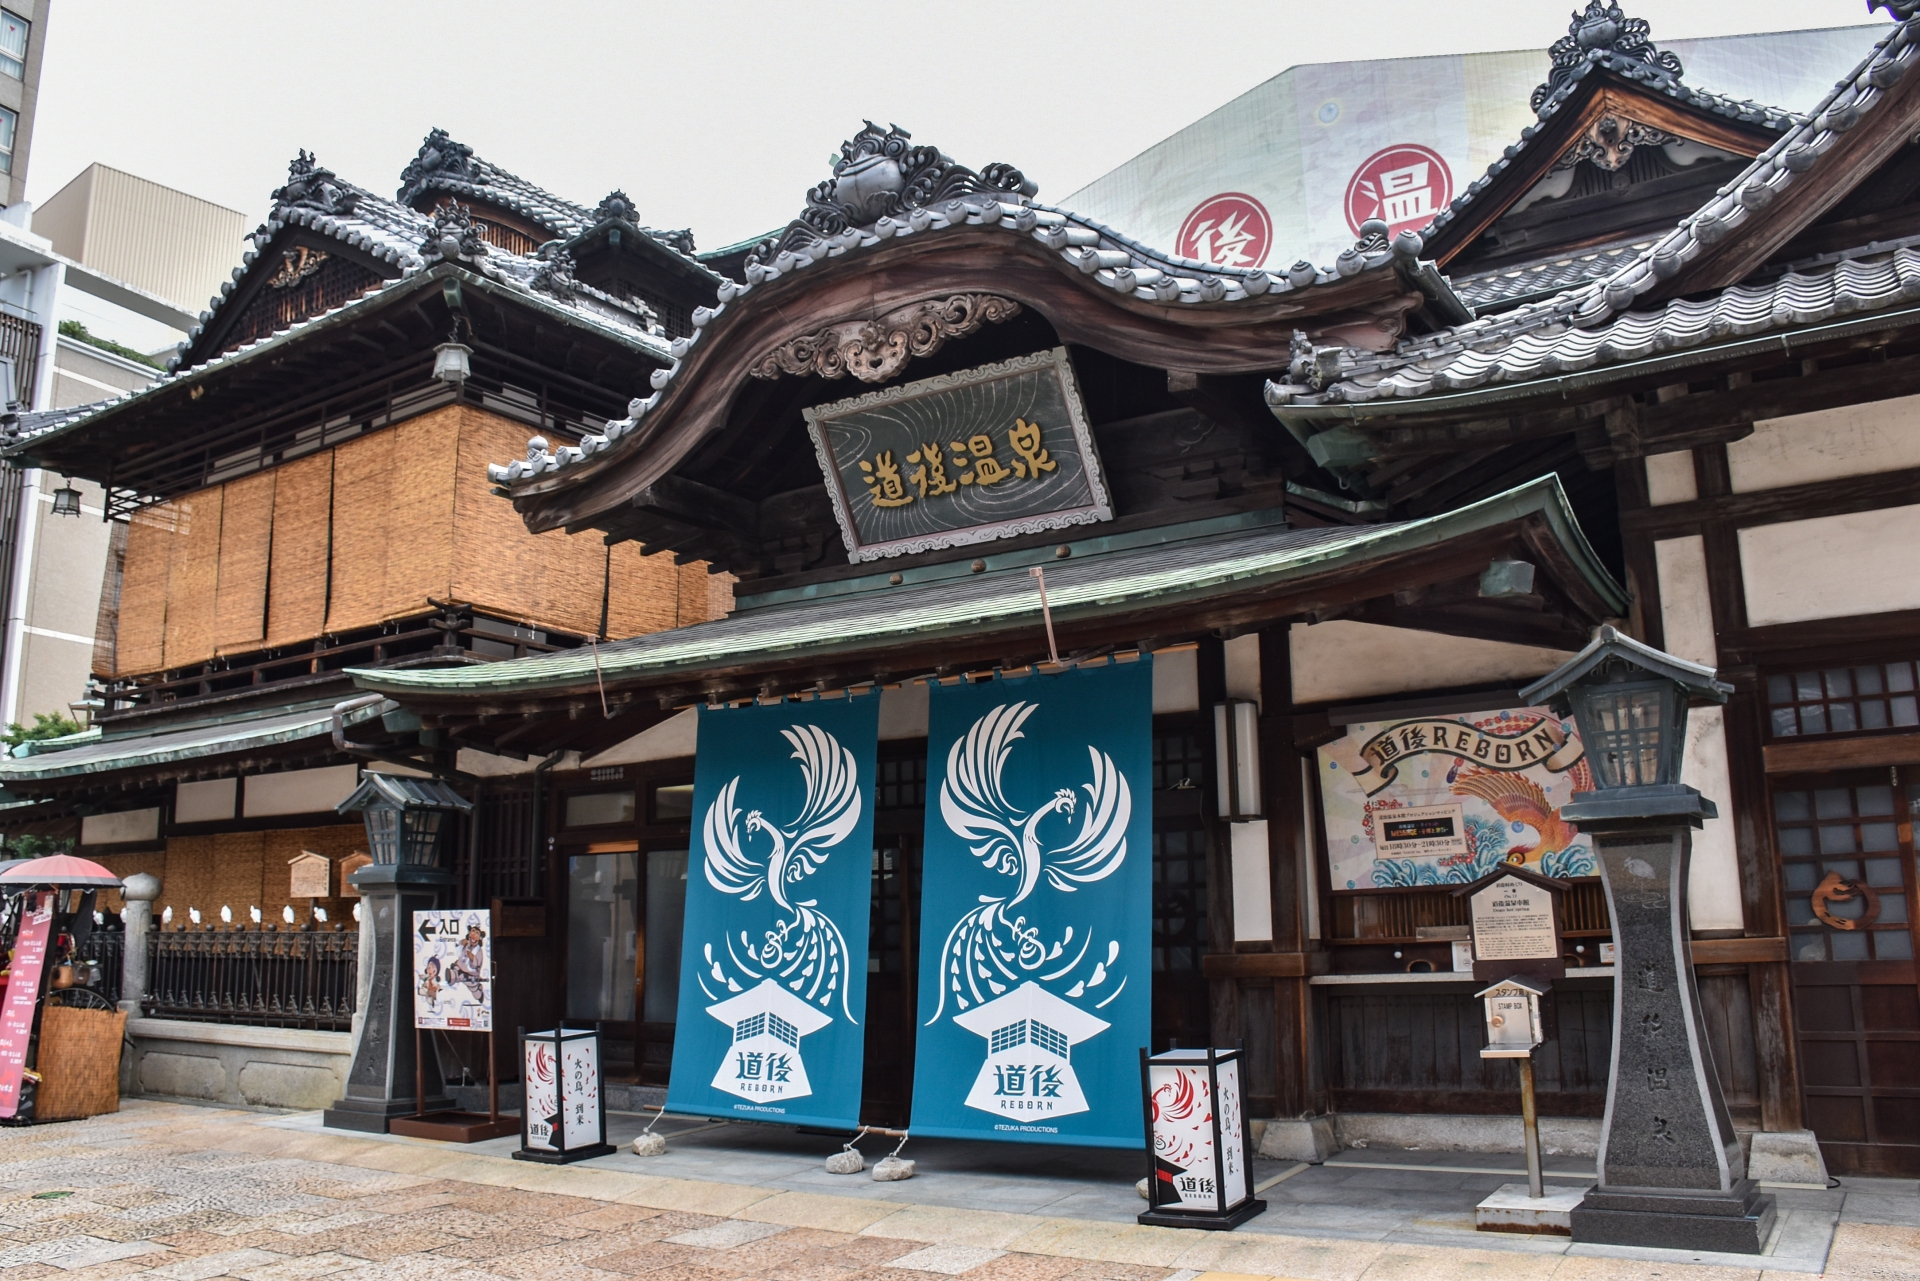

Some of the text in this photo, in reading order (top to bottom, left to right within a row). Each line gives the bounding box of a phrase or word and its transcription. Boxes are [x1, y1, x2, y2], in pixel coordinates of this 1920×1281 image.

[1190, 161, 1439, 267] 後 温
[858, 417, 1057, 507] 道後温泉
[439, 918, 459, 935] 入口
[1498, 1002, 1522, 1010] STAMP BOX
[735, 1052, 793, 1083] 道後
[740, 1082, 784, 1093] REBORN
[993, 1064, 1064, 1098] 道後
[754, 1105, 786, 1114] PRODUCTIONS
[1000, 1100, 1054, 1111] REBORN
[575, 1102, 584, 1126] 到来
[530, 1123, 549, 1136] 道後
[1020, 1125, 1058, 1134] PRODUCTIONS
[1226, 1146, 1234, 1176] 到来
[1179, 1177, 1216, 1193] 道後
